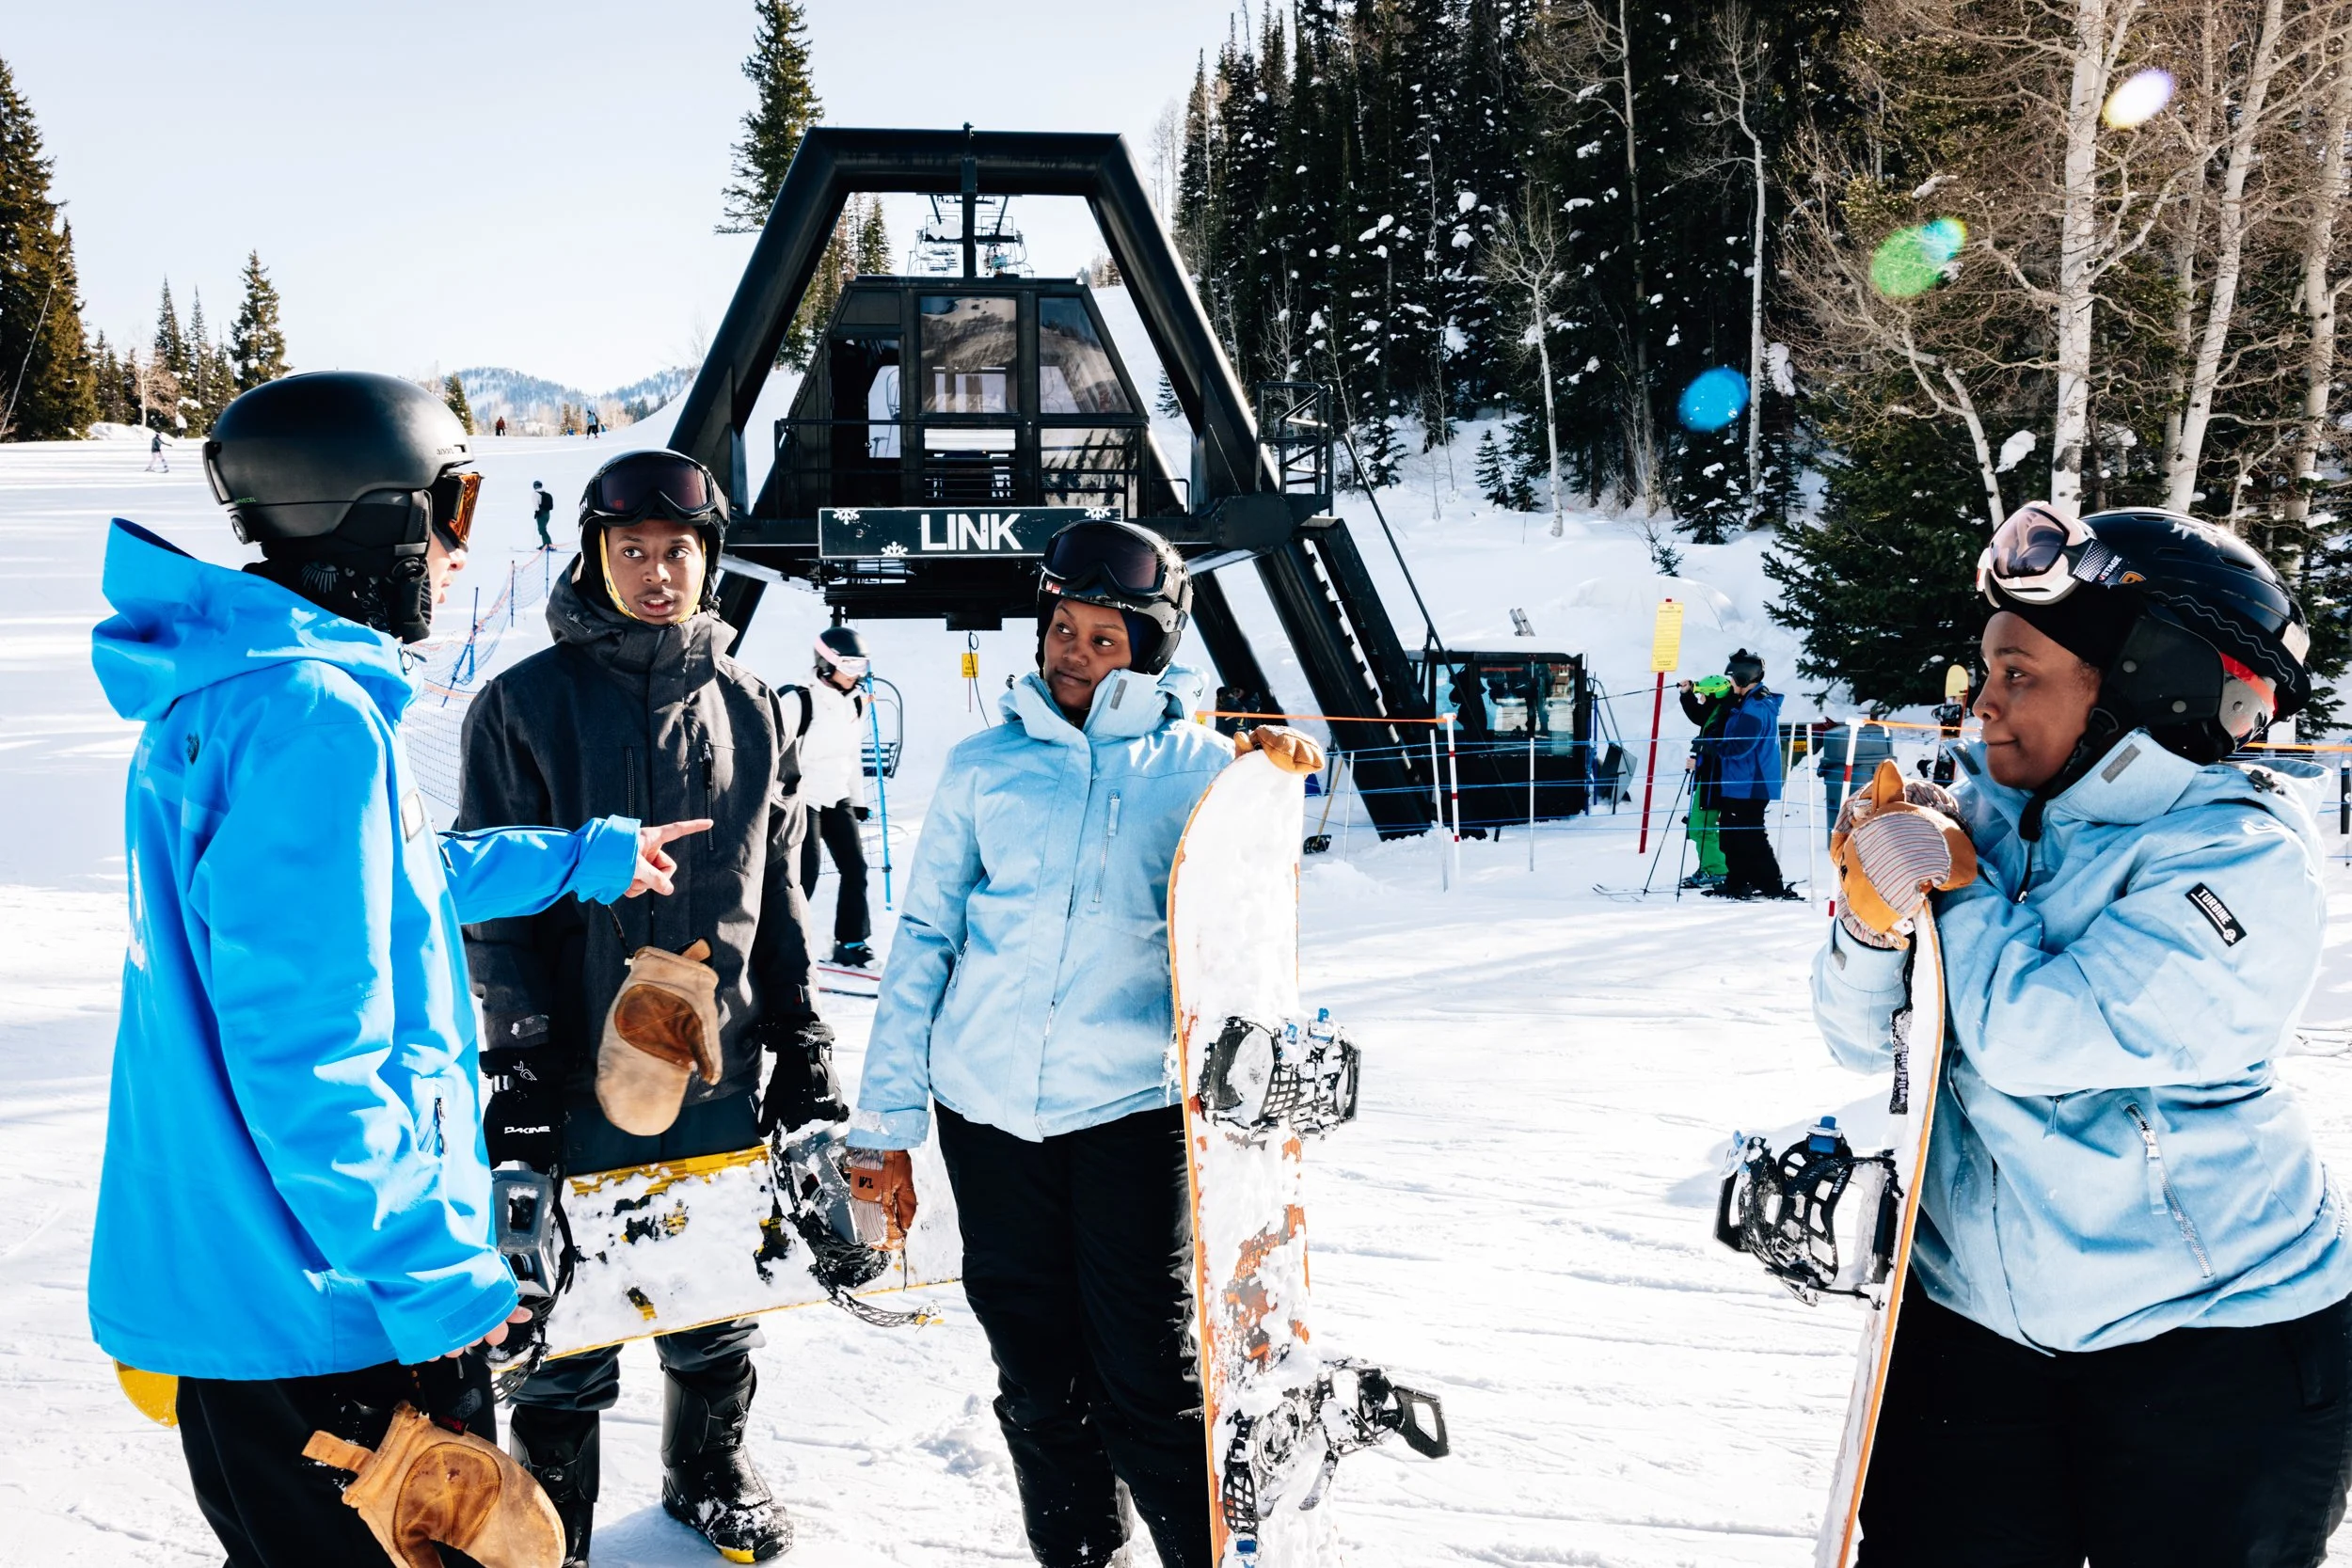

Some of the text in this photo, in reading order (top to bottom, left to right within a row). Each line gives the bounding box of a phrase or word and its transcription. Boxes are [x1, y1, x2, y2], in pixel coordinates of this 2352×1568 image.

[920, 513, 1024, 551] LINK
[2101, 554, 2123, 578] STAGE
[2198, 888, 2233, 926] TURBINE
[503, 1125, 551, 1135] DAKINE
[1832, 1169, 1848, 1194] REPLY
